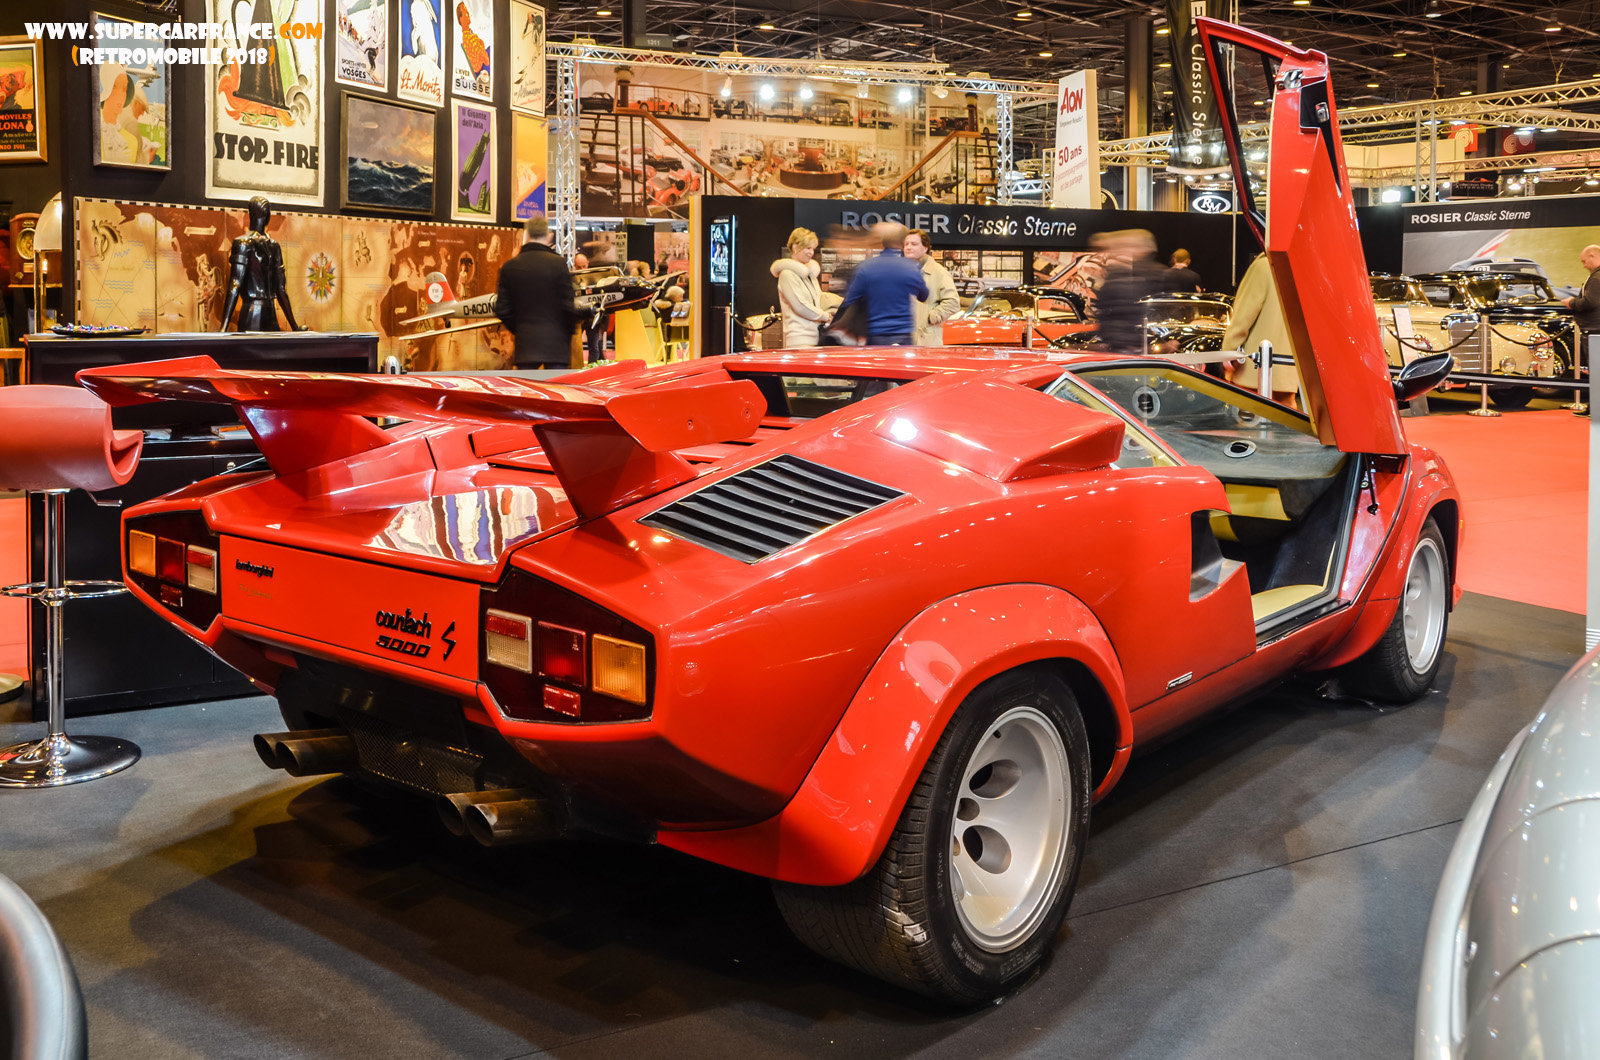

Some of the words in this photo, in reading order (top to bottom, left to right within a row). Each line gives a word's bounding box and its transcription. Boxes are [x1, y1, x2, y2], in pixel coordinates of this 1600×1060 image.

[341, 67, 367, 79] VOSGES
[412, 69, 441, 102] Moritz
[455, 78, 490, 95] SUISSE
[1191, 44, 1206, 104] Classic
[1192, 111, 1207, 165] Stere
[1058, 146, 1069, 166] 50
[1069, 145, 1083, 160] ans
[957, 213, 1017, 236] Classic
[1024, 215, 1077, 236] Sterne
[1411, 212, 1461, 224] ROSIER
[1464, 211, 1497, 222] Classic
[1499, 210, 1531, 221] Sterne
[376, 608, 432, 639] countach
[376, 634, 432, 658] 5000
[441, 620, 456, 662] S
